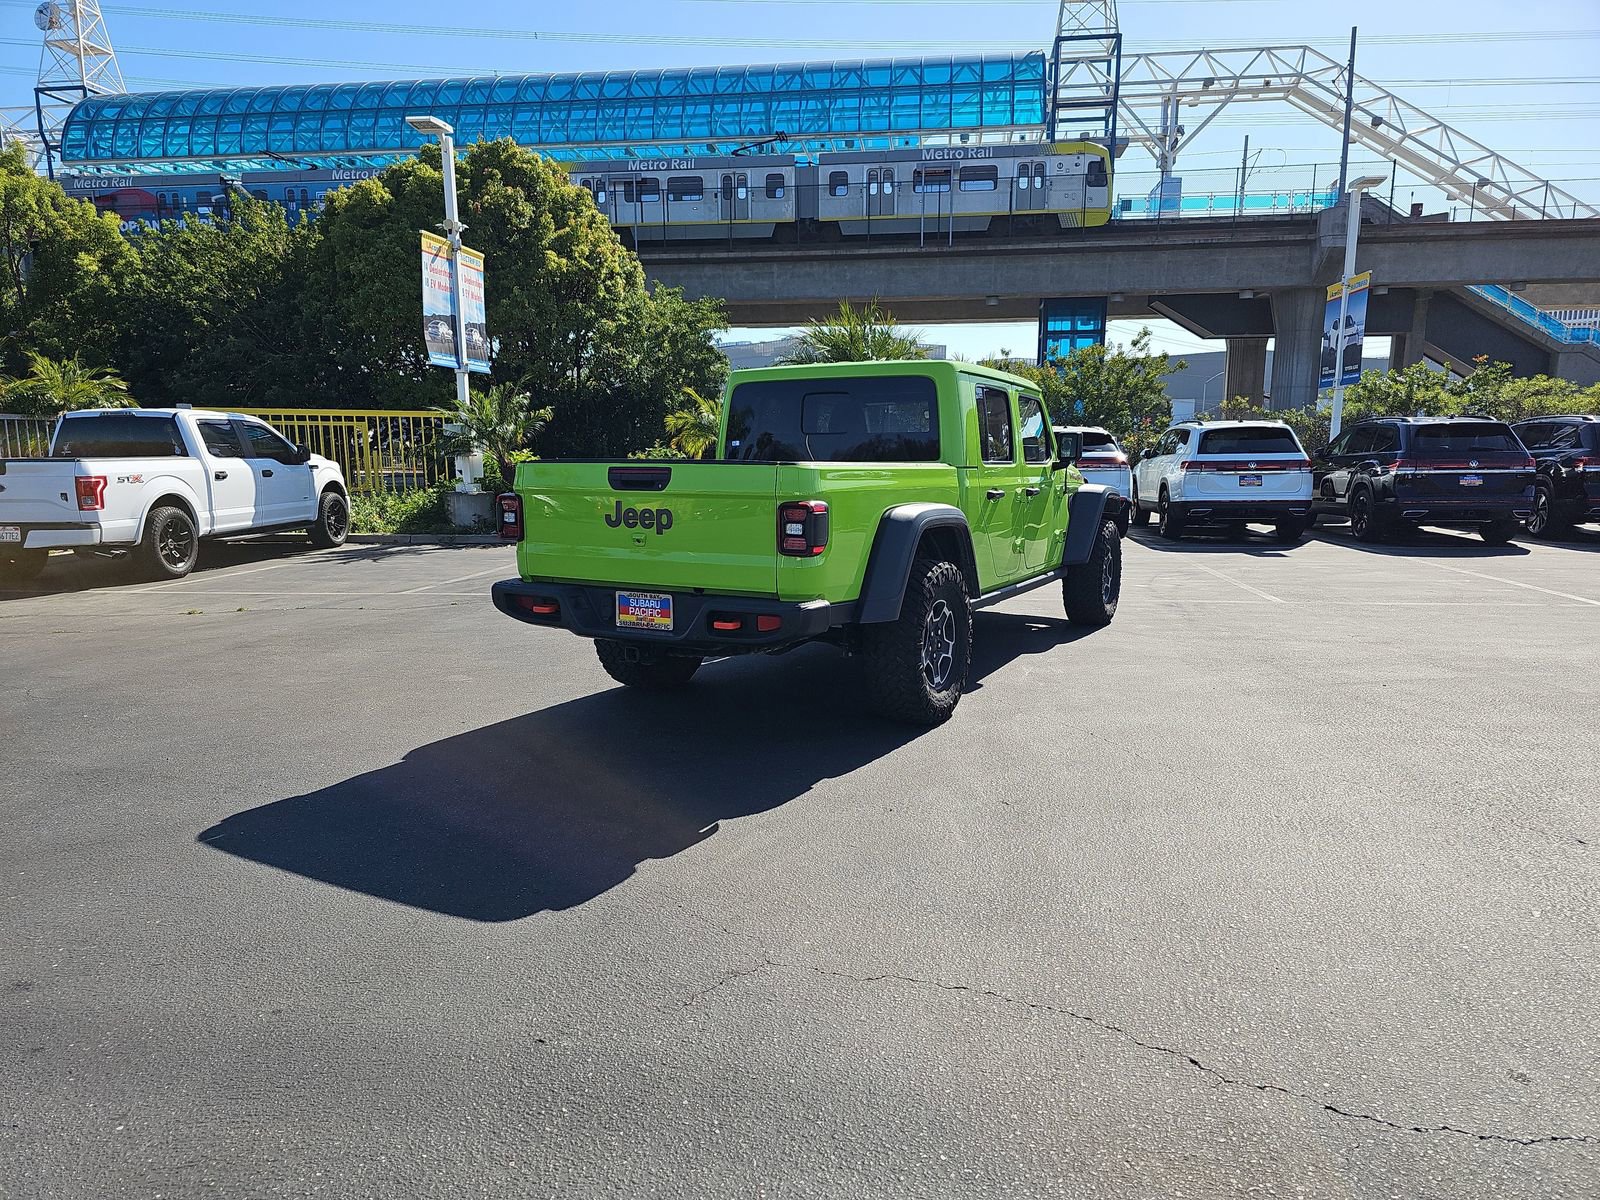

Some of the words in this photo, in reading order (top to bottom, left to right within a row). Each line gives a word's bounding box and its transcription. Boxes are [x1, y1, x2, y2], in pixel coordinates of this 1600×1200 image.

[922, 149, 966, 160] Metro
[968, 147, 993, 158] Rail
[628, 160, 667, 170] Metro
[671, 158, 695, 169] Rail
[332, 169, 369, 180] Metro
[73, 178, 109, 189] Metro
[111, 177, 133, 187] Rail
[430, 279, 437, 289] EV
[117, 475, 144, 483] STX
[605, 500, 673, 535] Jeep
[630, 598, 661, 609] SUBARU
[629, 607, 661, 618] PACIFIC
